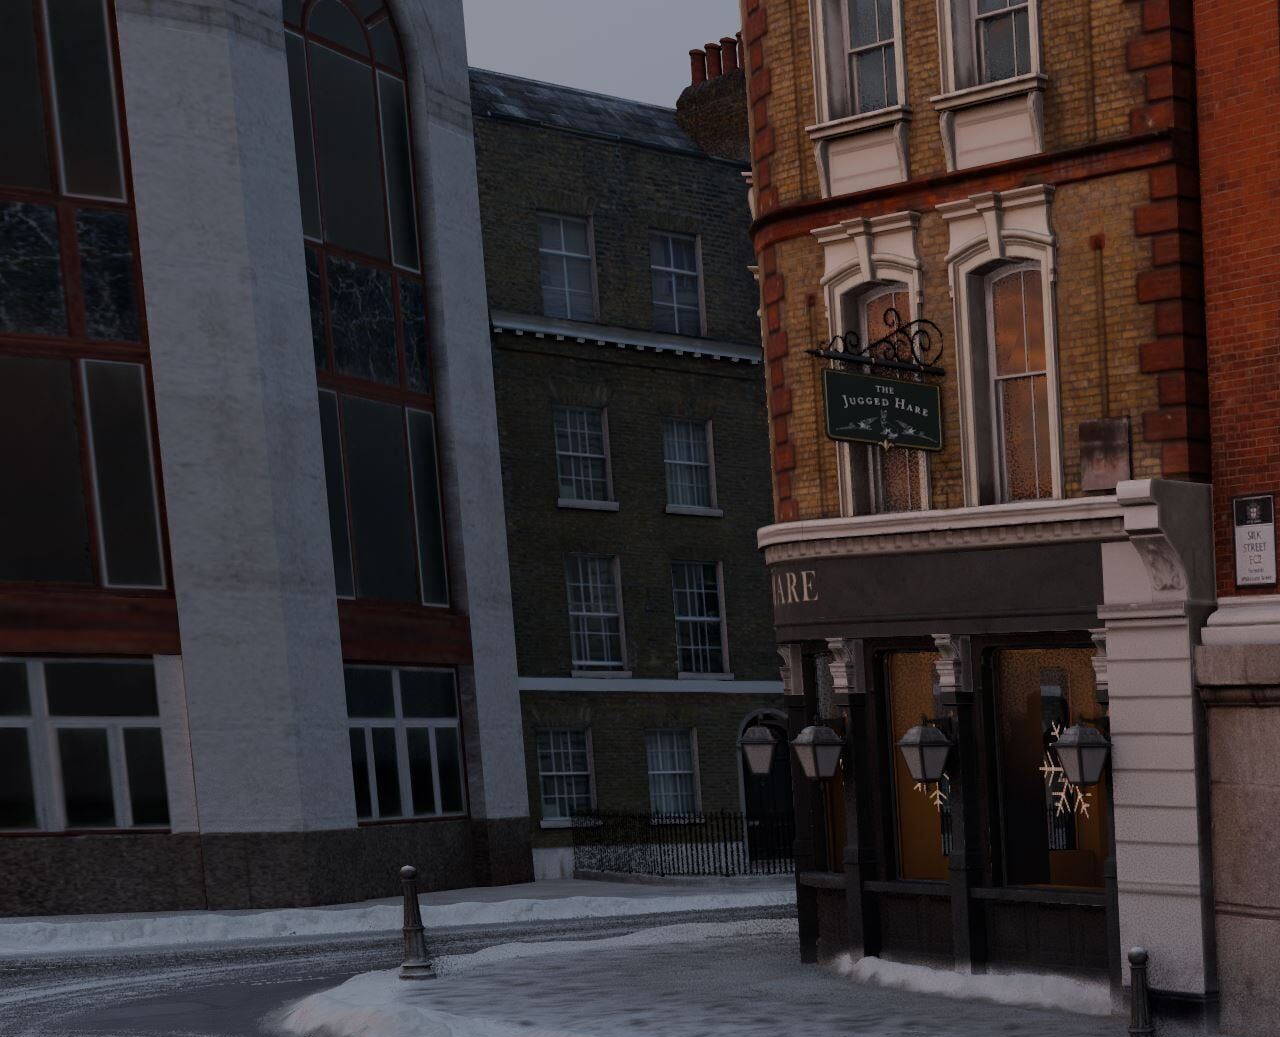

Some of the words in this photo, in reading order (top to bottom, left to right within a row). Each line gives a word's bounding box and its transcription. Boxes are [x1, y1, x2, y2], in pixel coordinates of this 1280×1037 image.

[875, 385, 895, 395] THE
[842, 394, 889, 409] JUGGED
[895, 397, 929, 417] HARE
[1243, 542, 1266, 553] STREET
